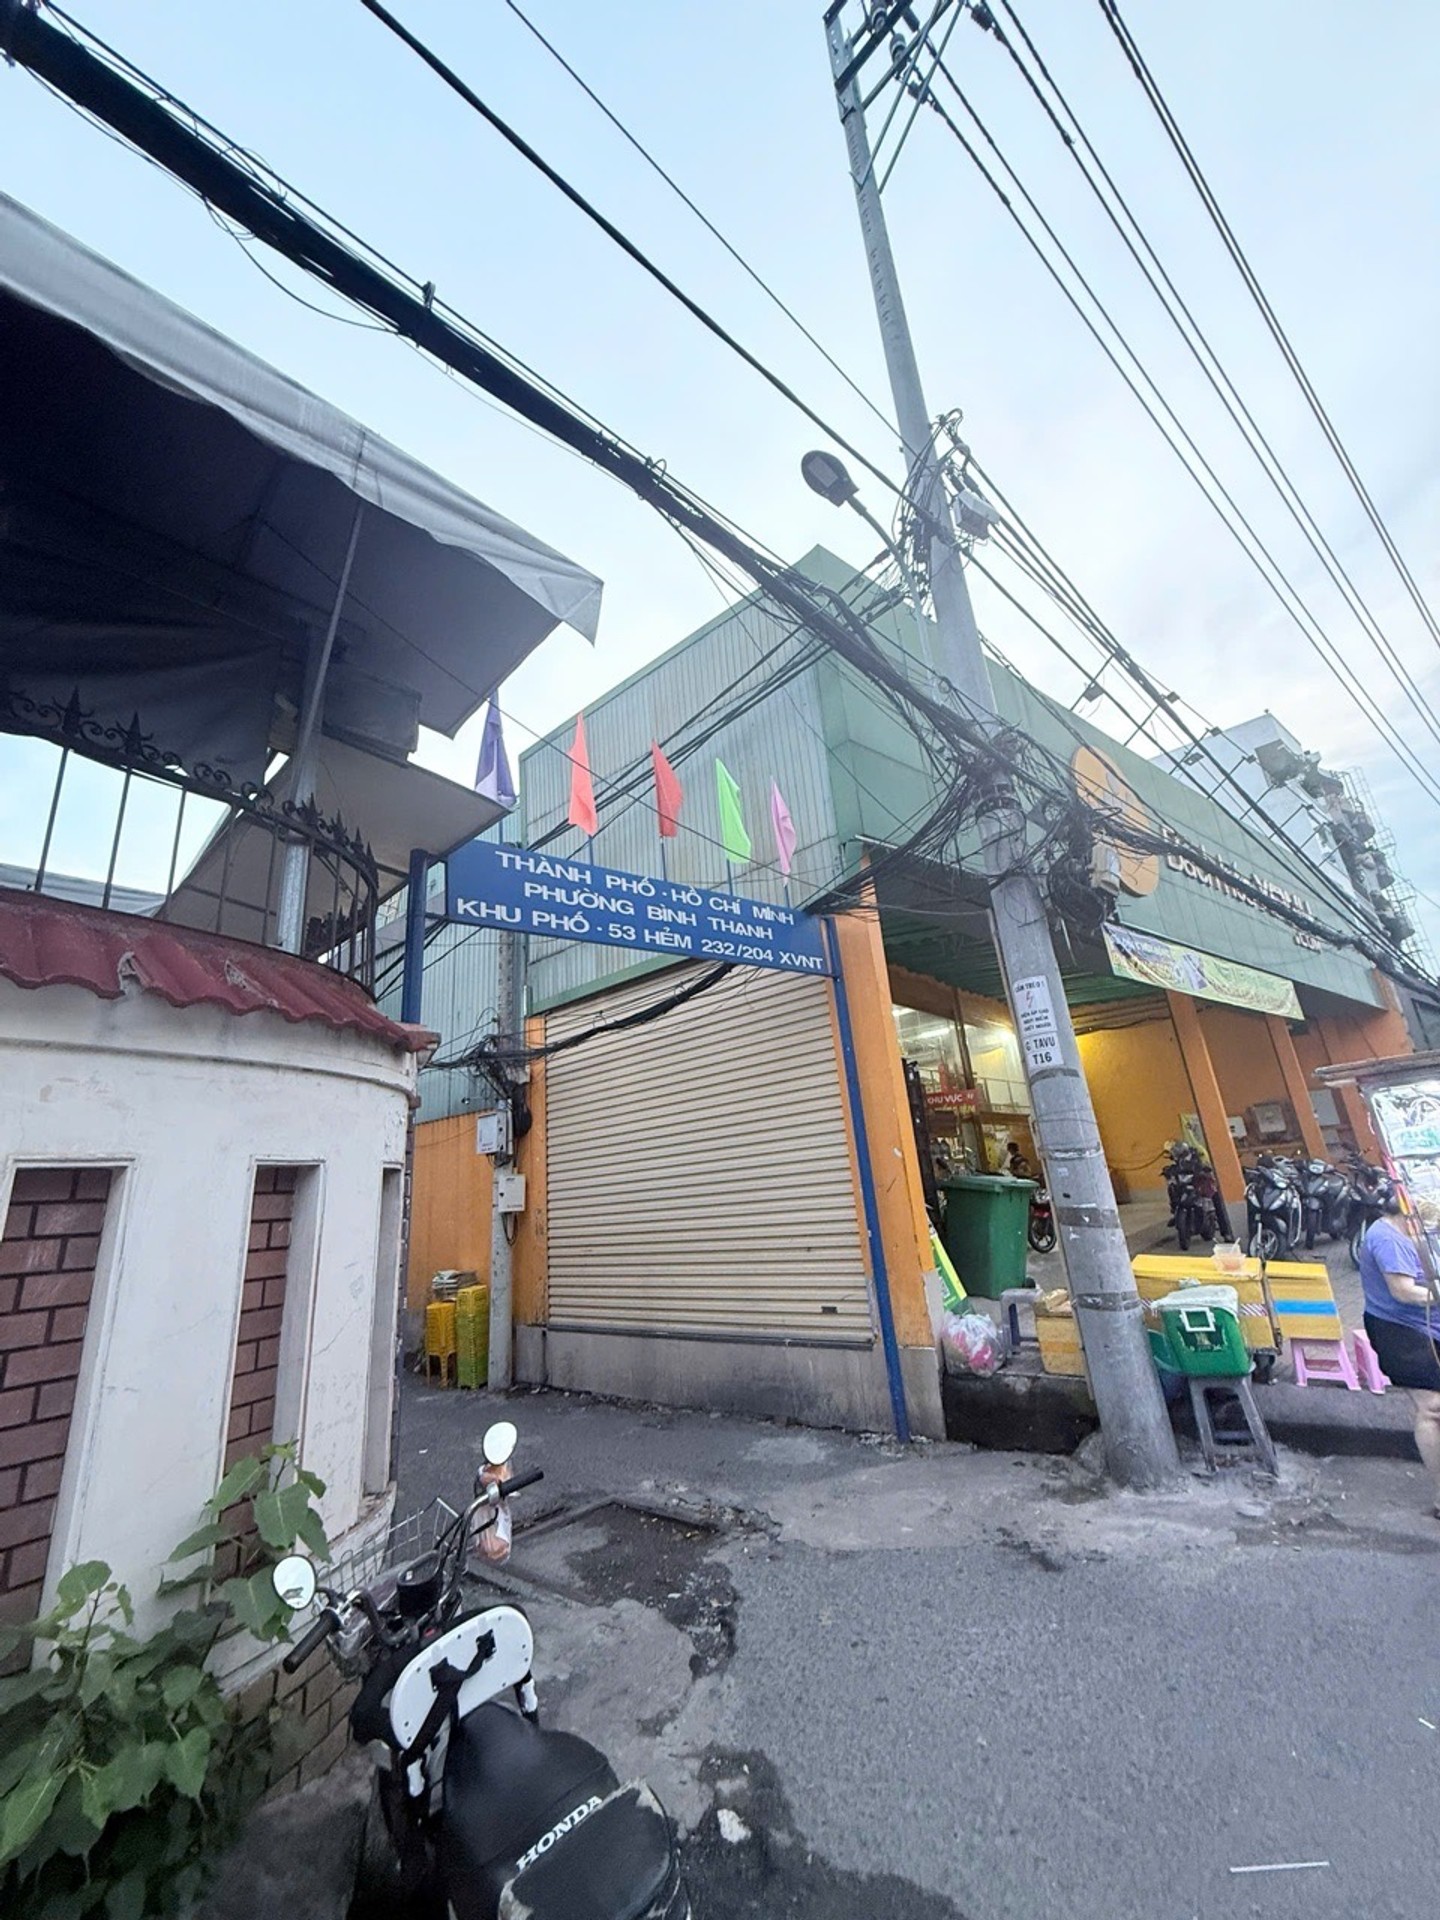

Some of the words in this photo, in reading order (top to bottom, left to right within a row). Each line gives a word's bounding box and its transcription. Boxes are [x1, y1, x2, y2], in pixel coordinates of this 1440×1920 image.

[495, 850, 592, 885] THÀNH
[605, 876, 656, 897] PHỐ
[670, 884, 703, 906] HỒ
[709, 897, 741, 915] CHÍ
[524, 881, 635, 916] PHƯỜNG
[646, 903, 698, 927] BÌNH
[457, 897, 522, 923] KHU
[532, 911, 590, 933] PHỐ
[608, 923, 636, 941] 53
[643, 926, 693, 950] HẺM
[700, 939, 774, 962] 232/204
[779, 950, 823, 970] XVNT
[1032, 1051, 1052, 1064] T16
[516, 1795, 603, 1872] HONDA
